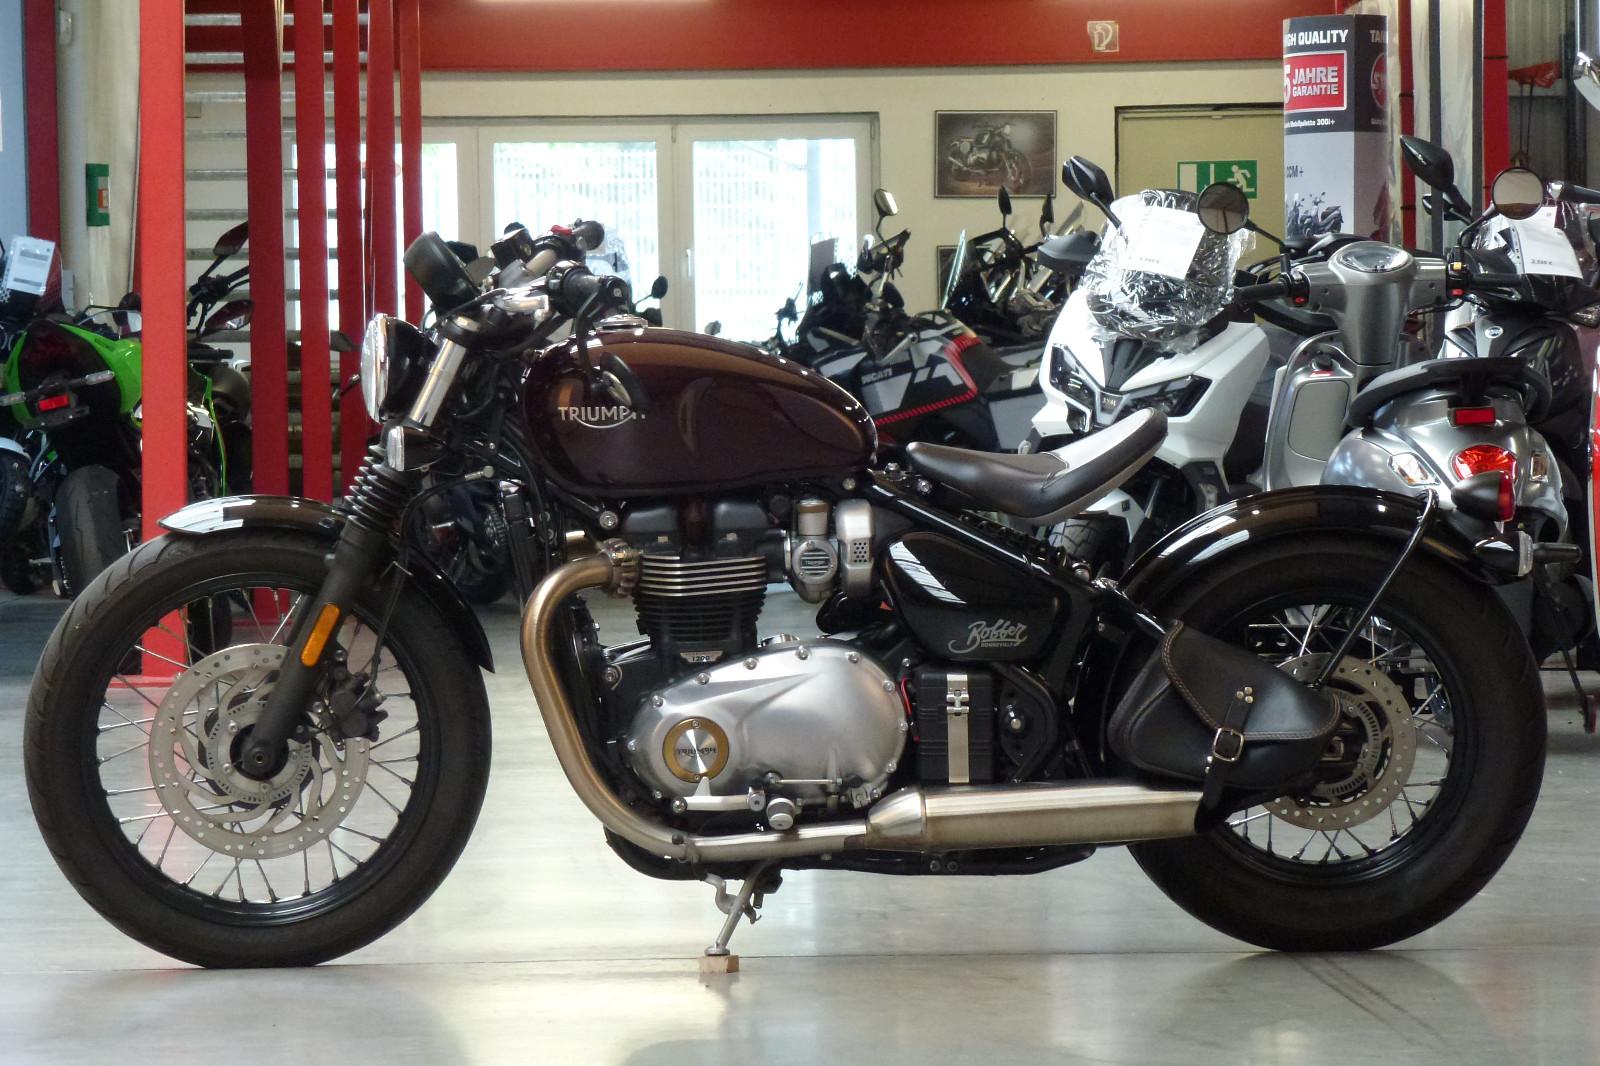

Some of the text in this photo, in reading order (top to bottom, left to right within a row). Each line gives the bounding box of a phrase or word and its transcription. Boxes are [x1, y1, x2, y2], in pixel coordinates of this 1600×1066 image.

[1298, 29, 1348, 45] QUALITY
[1292, 66, 1338, 84] JAHRE
[1292, 84, 1339, 97] GARANTIE
[948, 618, 1028, 653] Bobber
